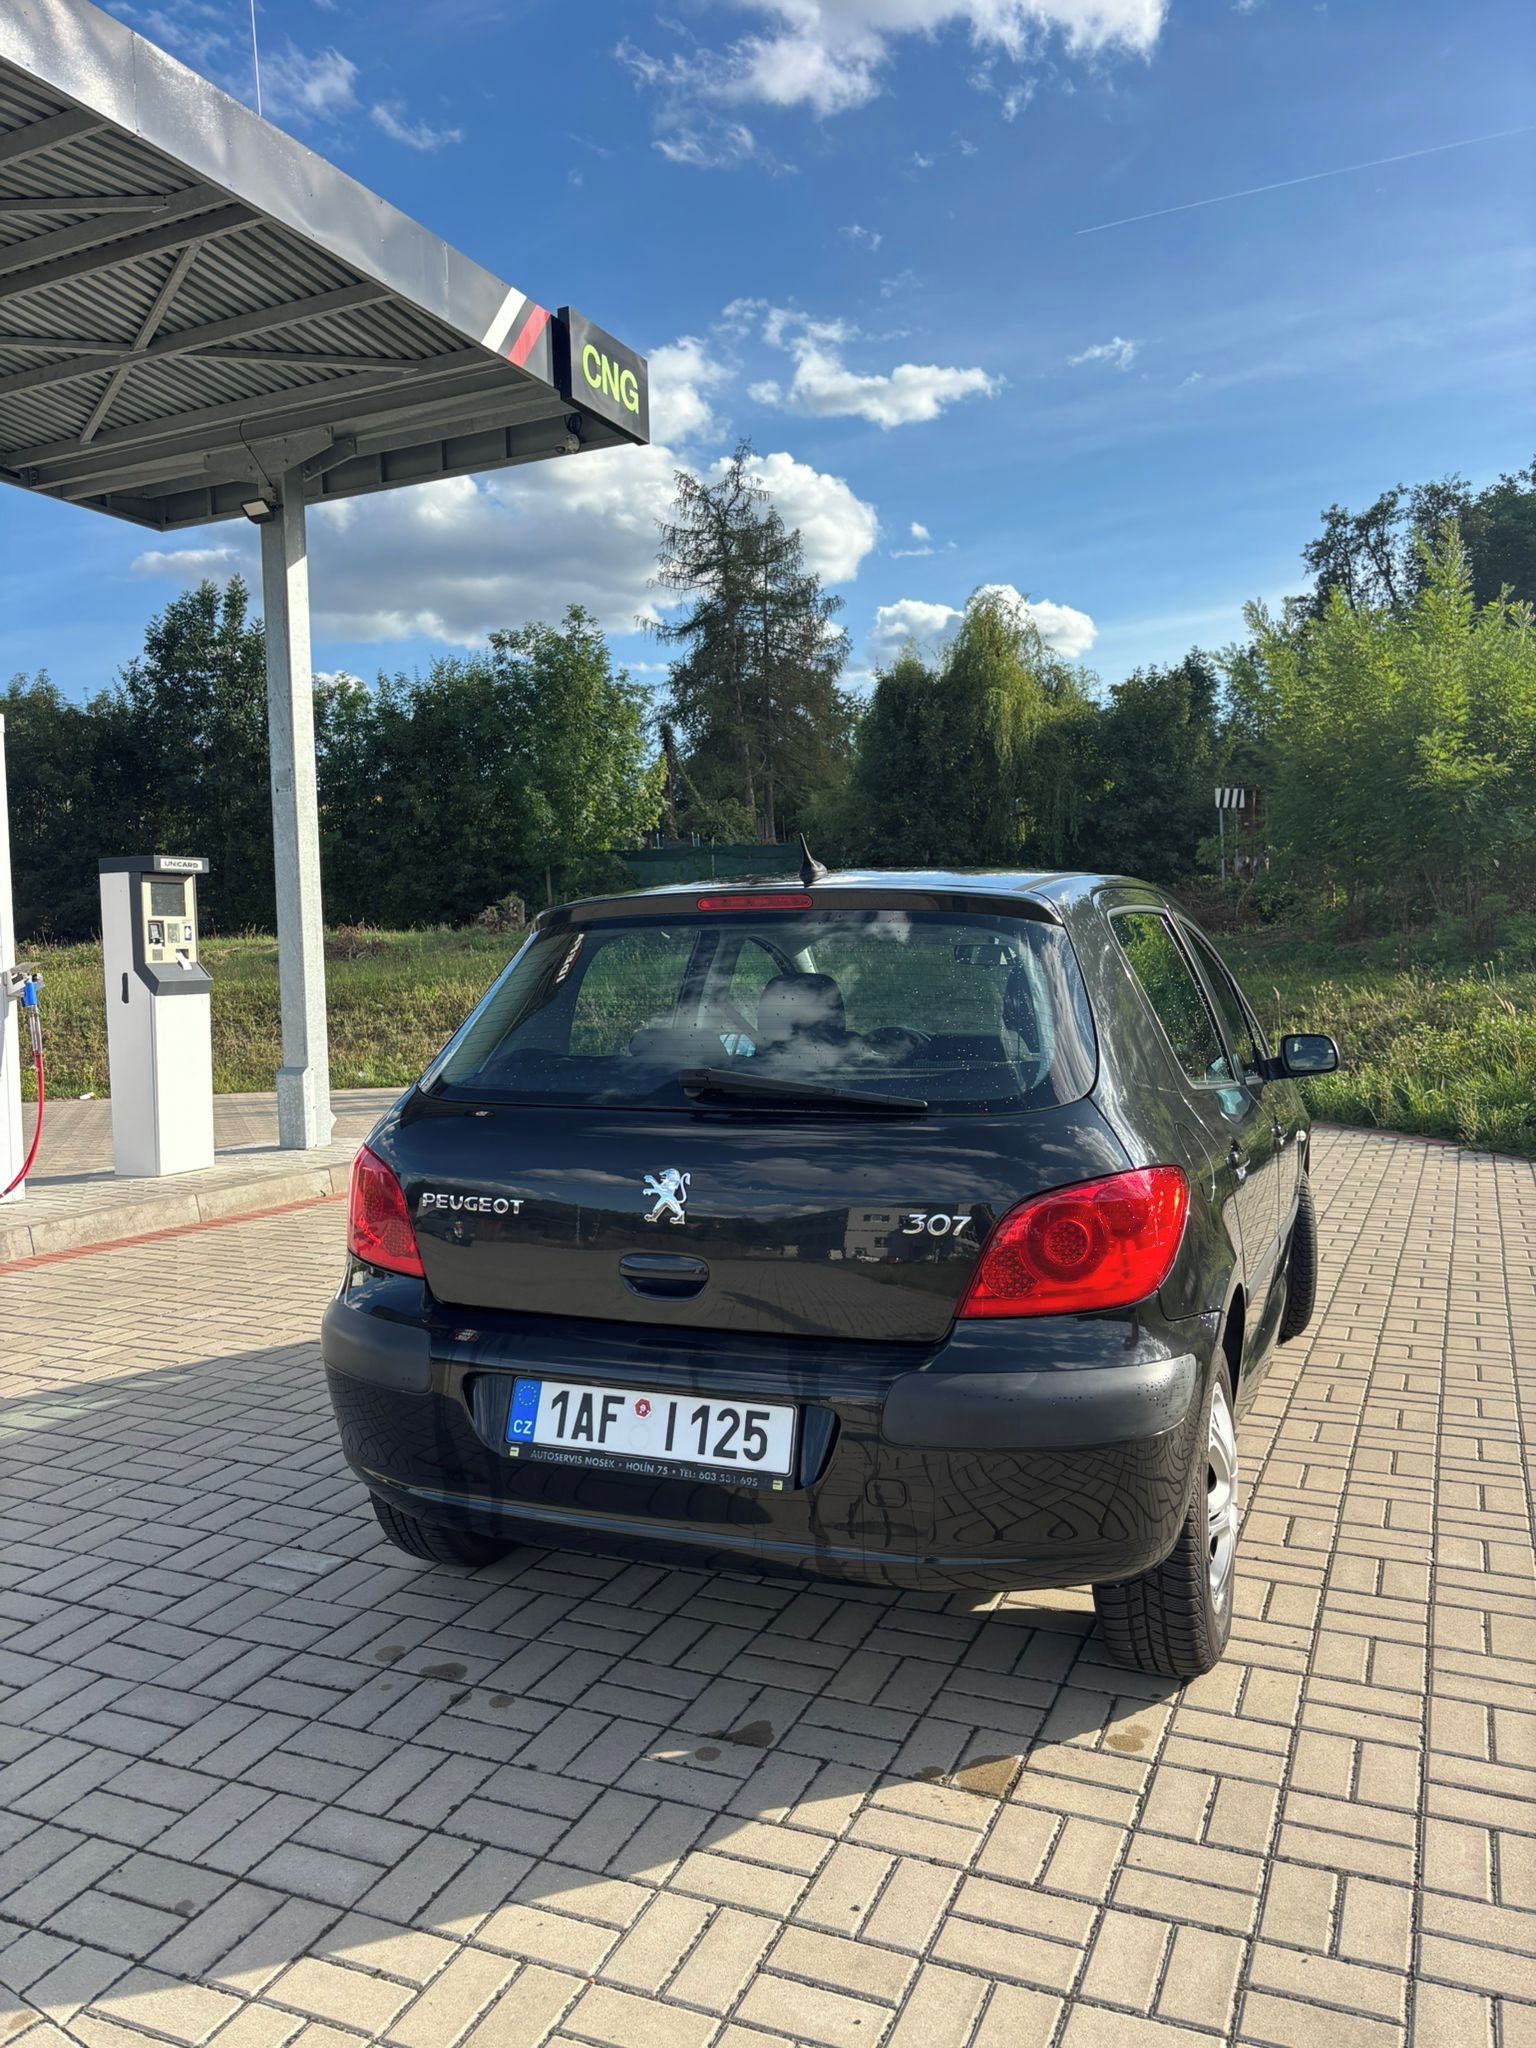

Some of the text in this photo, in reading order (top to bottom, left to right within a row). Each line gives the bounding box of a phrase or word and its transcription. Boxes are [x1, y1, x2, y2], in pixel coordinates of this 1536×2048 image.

[582, 344, 639, 414] CNG
[164, 860, 199, 869] UNICARD
[422, 1192, 524, 1215] PEUGEOT
[902, 1213, 972, 1237] 307
[513, 1419, 532, 1434] CZ
[550, 1390, 626, 1444] 1AF
[530, 1449, 583, 1465] AUTOSERVIS
[584, 1456, 615, 1468] NOSEK
[656, 1465, 668, 1475] 75
[698, 1471, 717, 1481] 603
